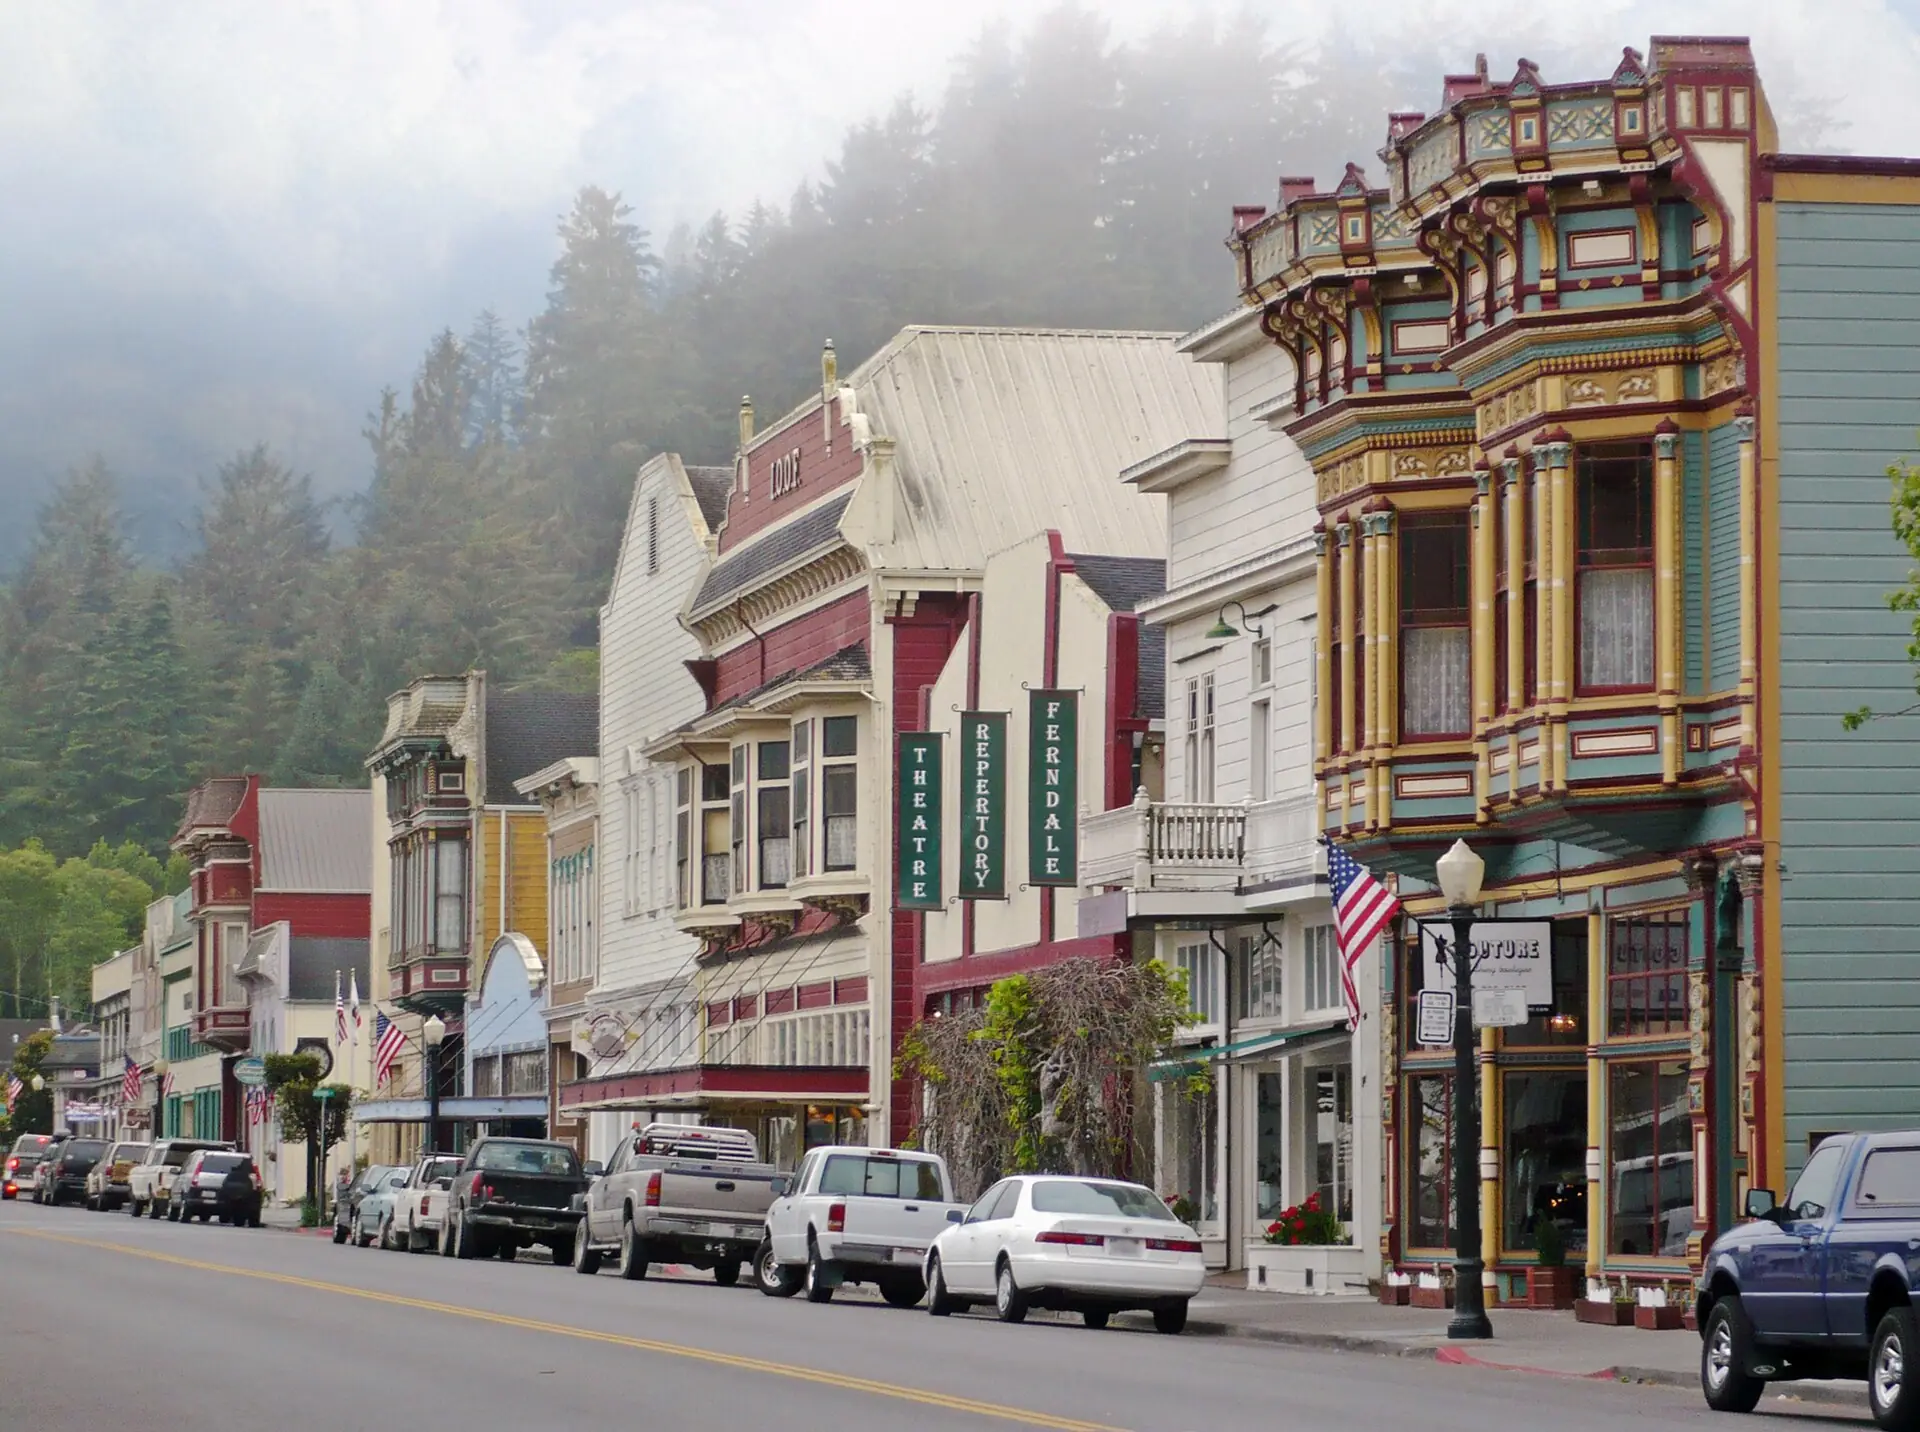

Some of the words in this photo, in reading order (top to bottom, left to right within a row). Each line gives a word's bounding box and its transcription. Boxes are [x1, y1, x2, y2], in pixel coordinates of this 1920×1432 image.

[912, 747, 928, 898] THEATRE
[975, 723, 990, 888] REPERTORY
[1044, 702, 1062, 874] FERNDALE
[1449, 938, 1540, 959] OUTURE
